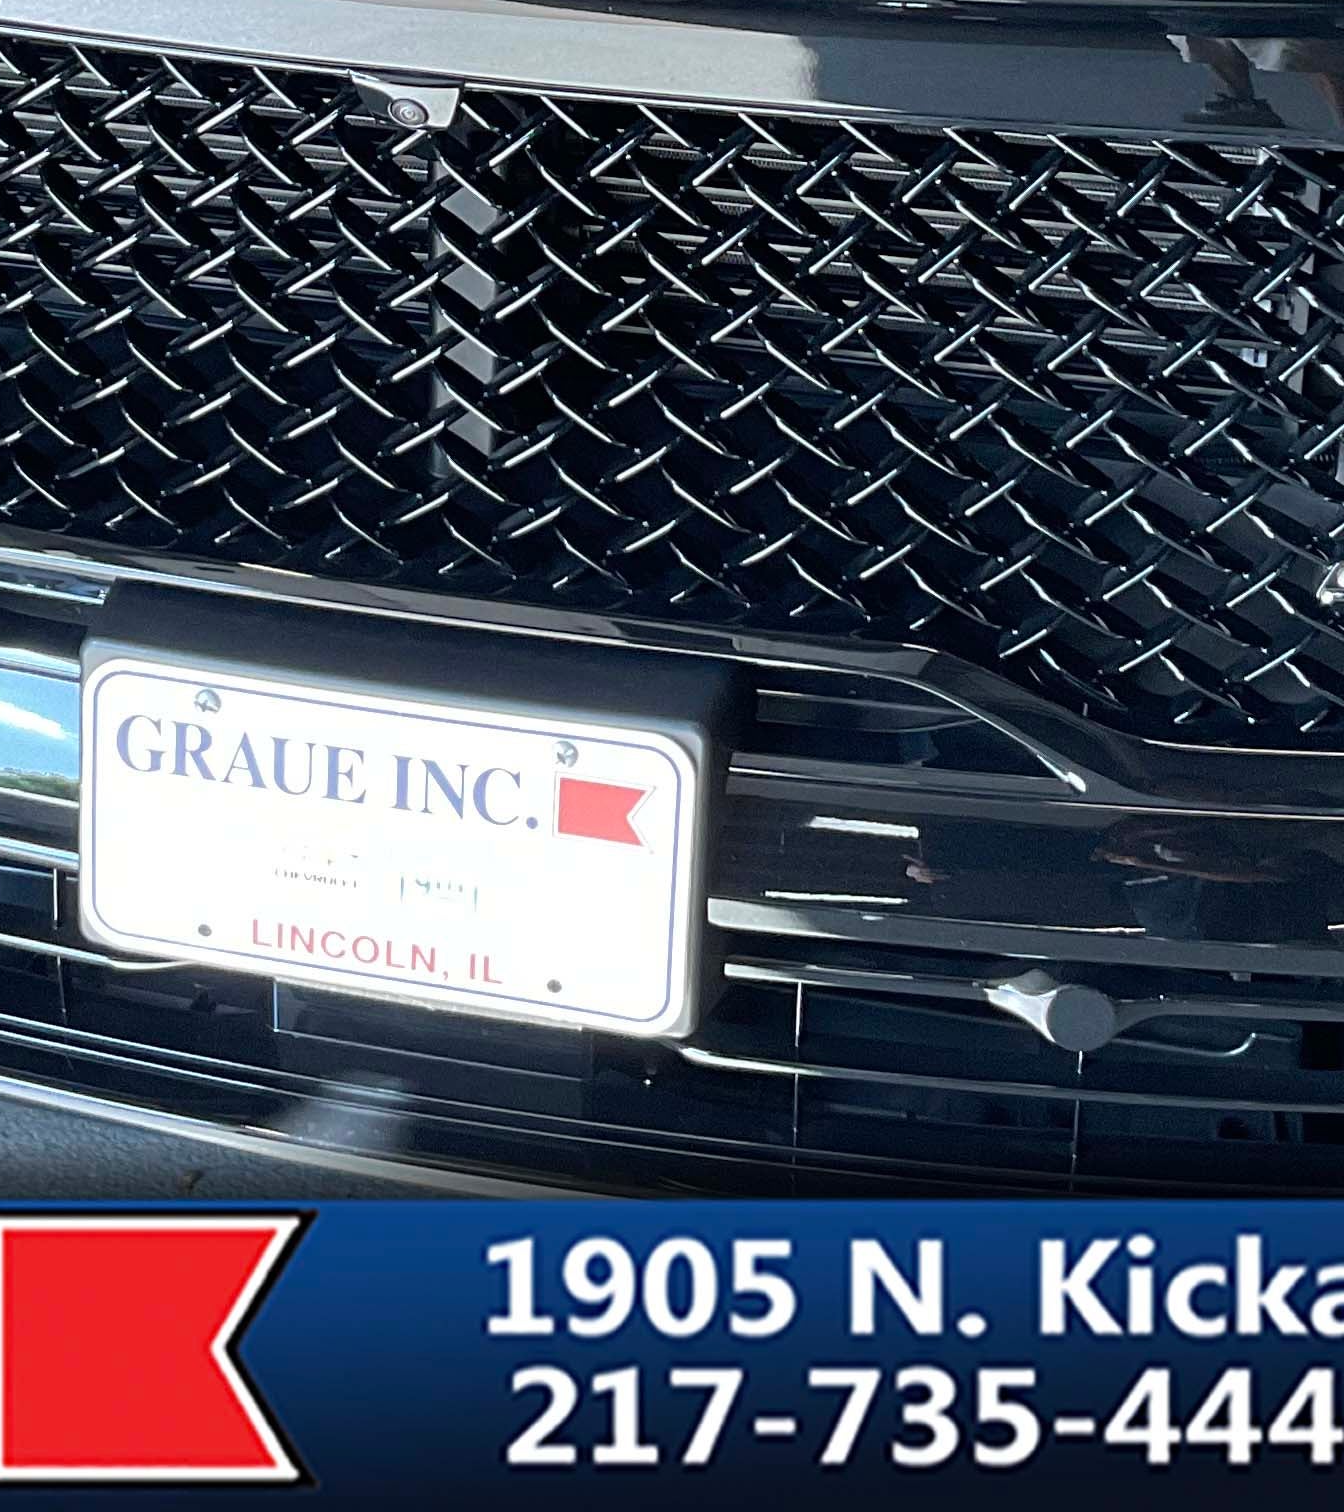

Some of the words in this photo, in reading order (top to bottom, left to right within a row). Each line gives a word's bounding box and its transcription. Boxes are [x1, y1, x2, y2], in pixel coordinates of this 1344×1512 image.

[115, 713, 367, 806] GRAUE
[390, 753, 539, 830] INC.
[252, 919, 449, 981] LINCOLN,
[469, 953, 503, 985] IL
